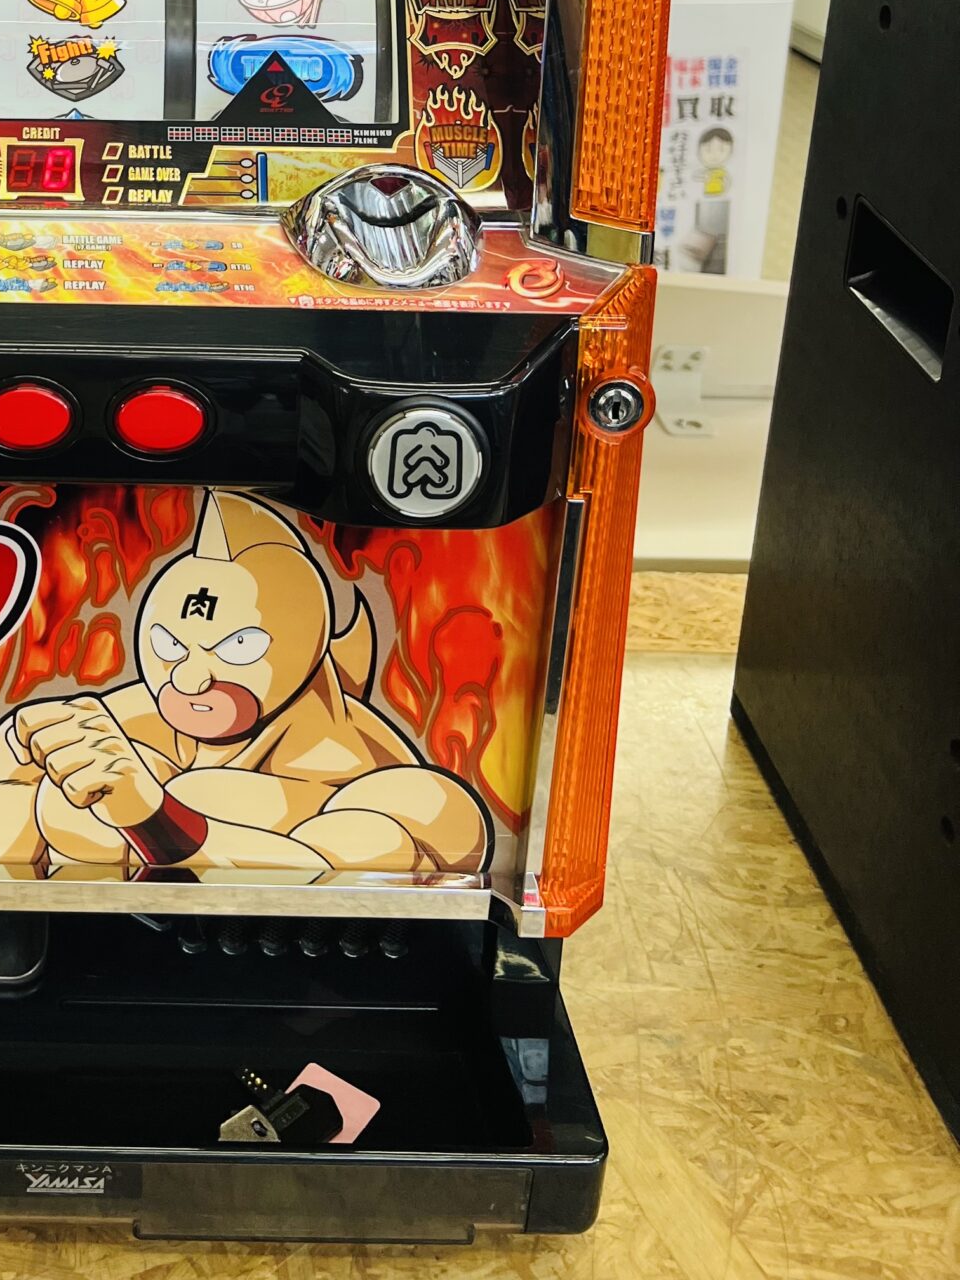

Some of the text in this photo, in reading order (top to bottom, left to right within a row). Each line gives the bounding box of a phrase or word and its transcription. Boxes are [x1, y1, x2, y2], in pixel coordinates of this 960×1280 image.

[38, 35, 94, 66] Fight!
[22, 127, 61, 140] CREDIT
[429, 125, 488, 143] MUSCLE
[128, 144, 173, 160] BATTLE
[441, 141, 478, 159] TIME
[128, 167, 154, 182] GAME
[128, 189, 173, 204] REPLAY
[62, 235, 124, 245] BATTLE GAME
[62, 259, 104, 270] REPLAY
[63, 280, 106, 291] REPLAY
[180, 587, 219, 621] 肉
[24, 1172, 106, 1190] YAMASA
